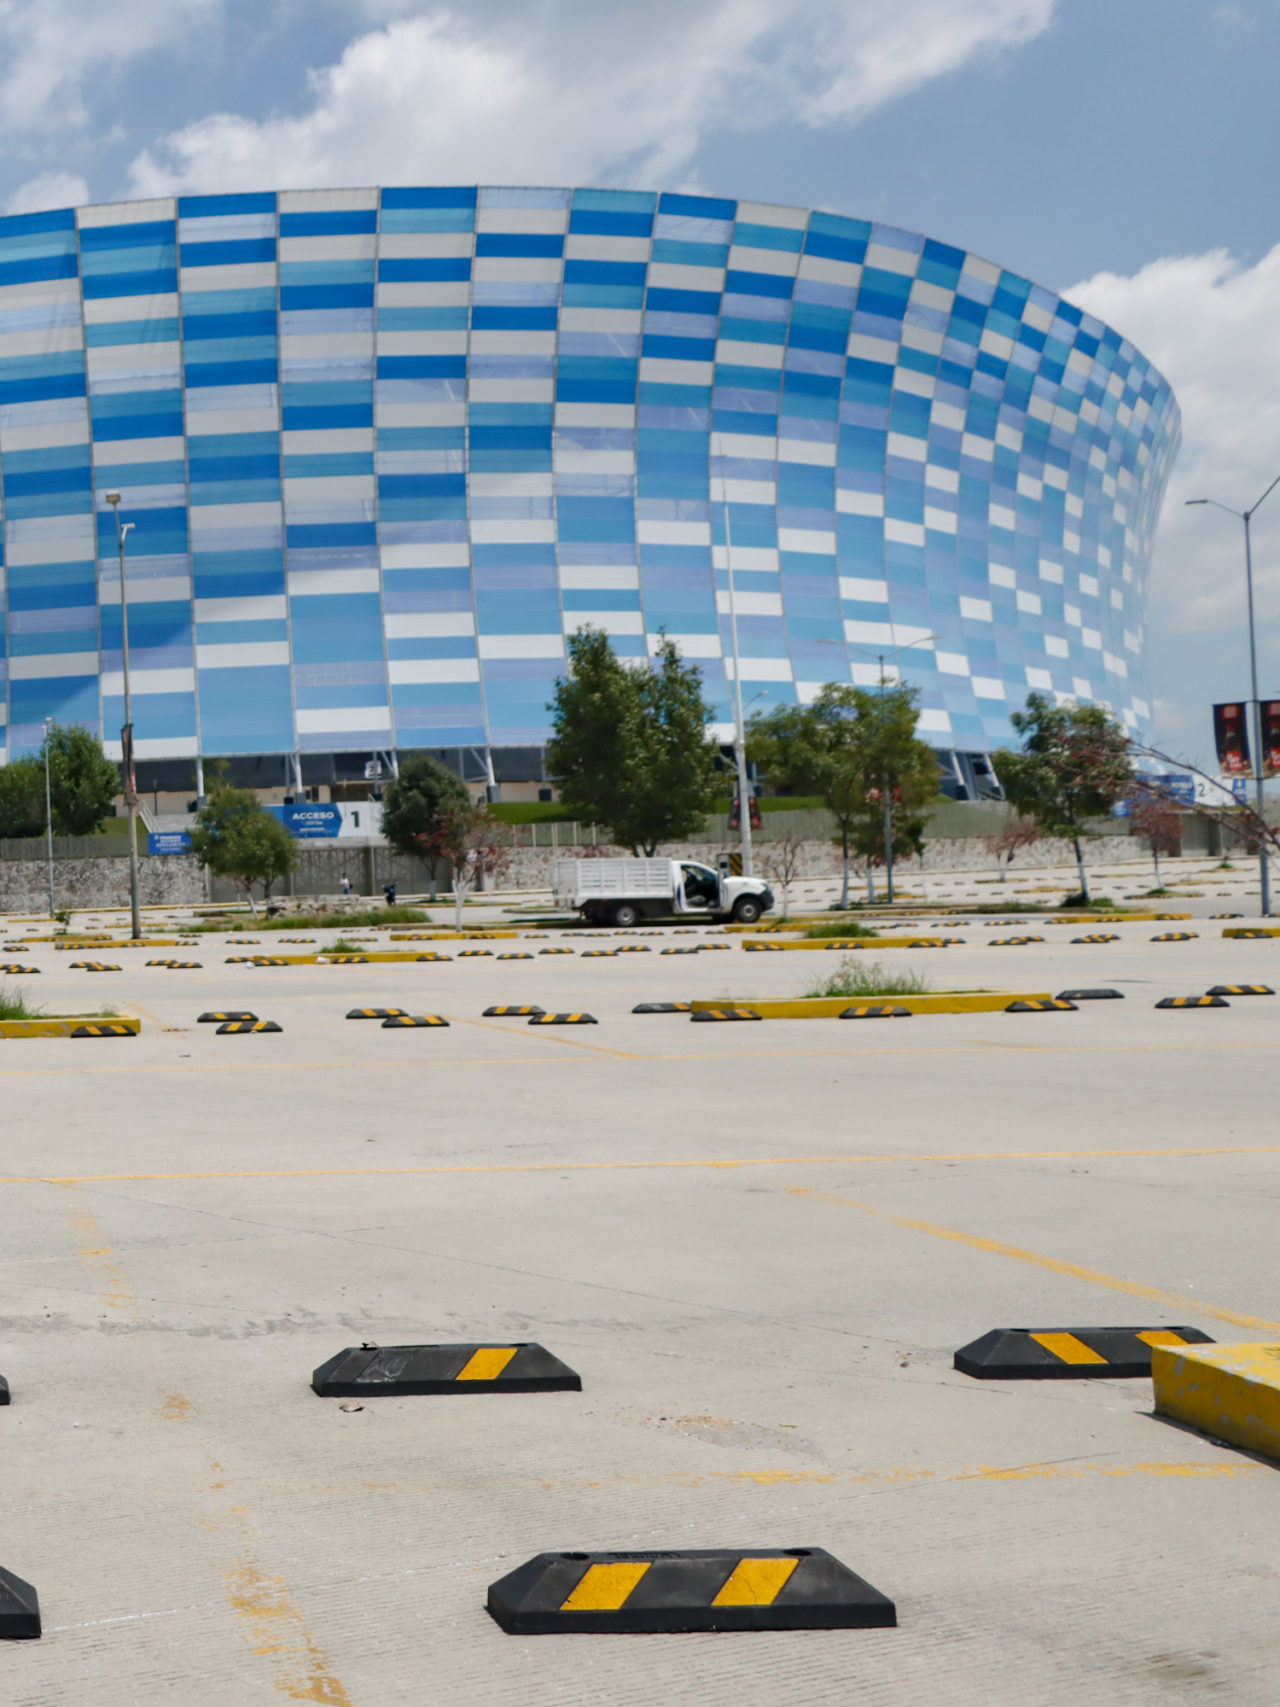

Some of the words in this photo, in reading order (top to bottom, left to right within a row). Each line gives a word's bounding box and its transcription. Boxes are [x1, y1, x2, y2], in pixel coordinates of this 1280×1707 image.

[1197, 783, 1205, 797] 2
[292, 811, 335, 820] ACCESO
[350, 810, 360, 828] 1
